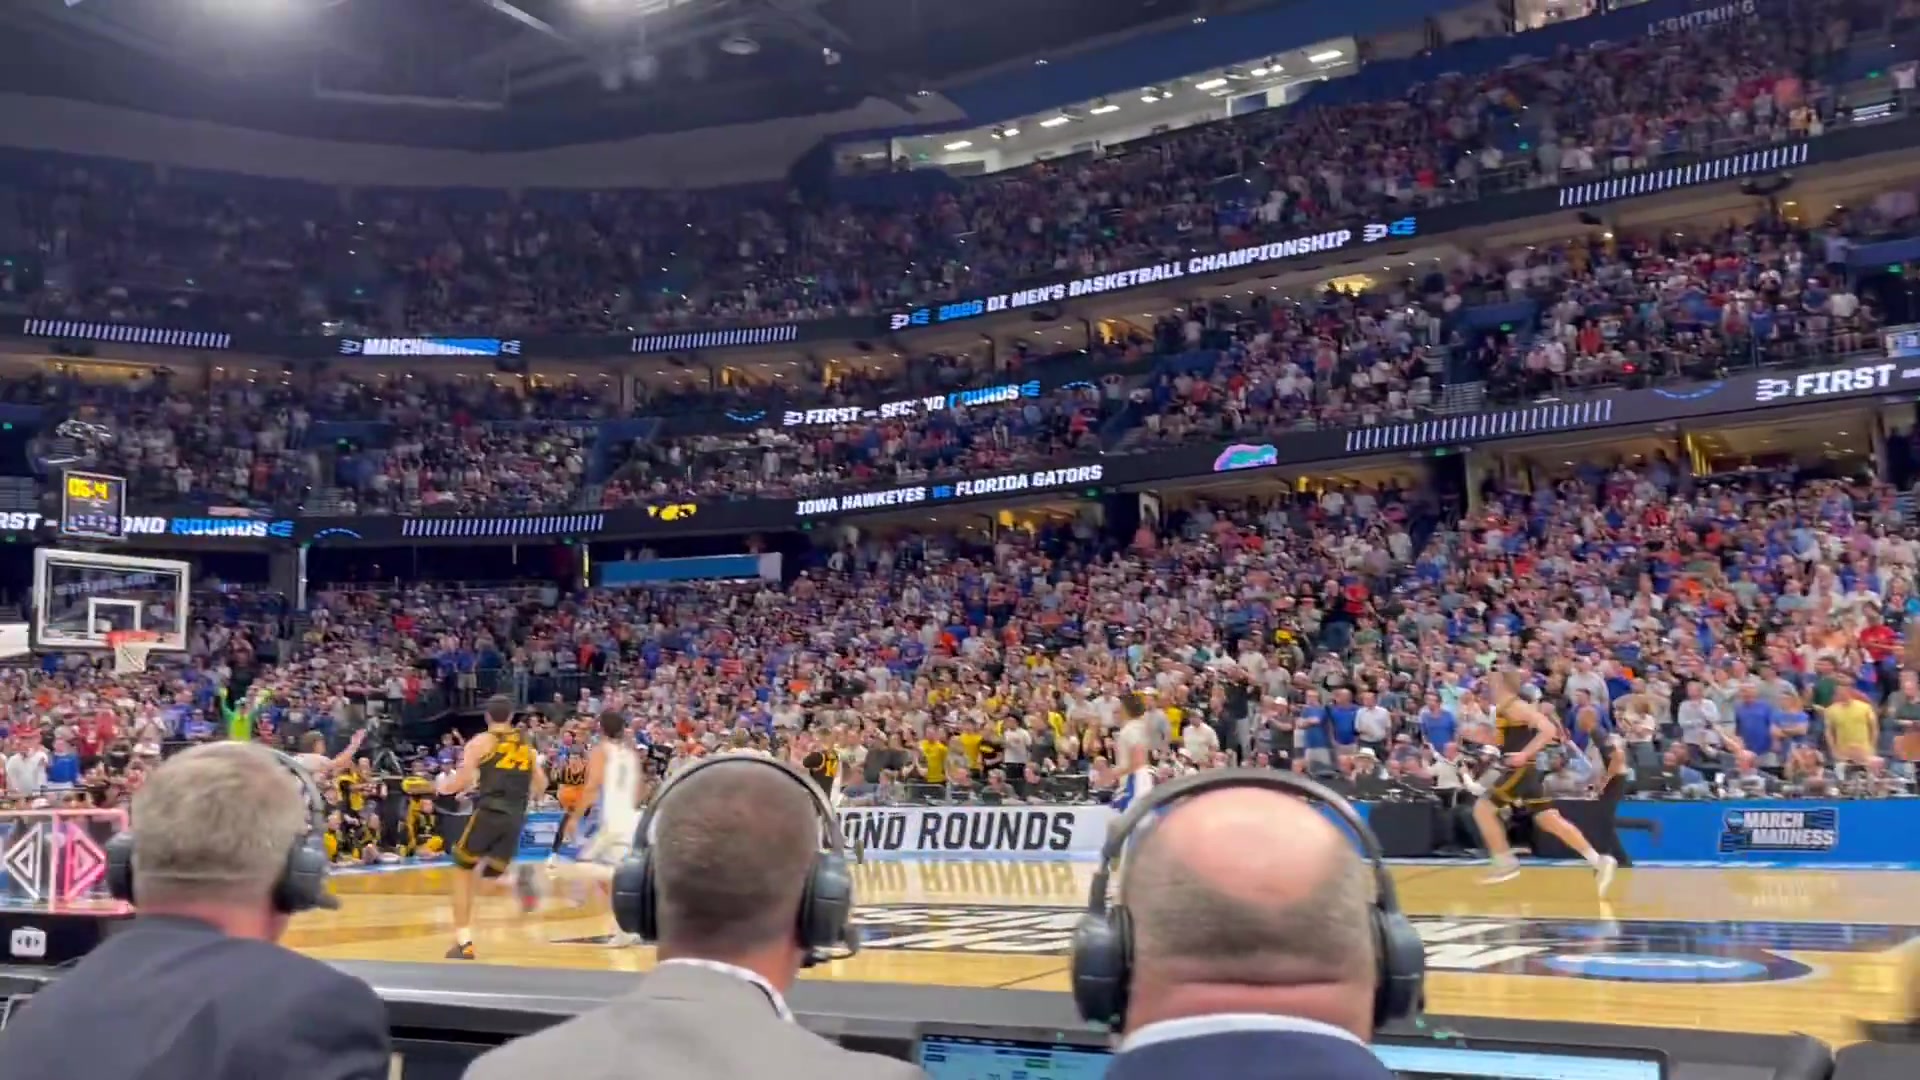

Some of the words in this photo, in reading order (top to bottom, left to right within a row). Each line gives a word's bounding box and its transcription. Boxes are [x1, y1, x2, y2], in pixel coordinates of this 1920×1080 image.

[986, 295, 1009, 312] DI
[1011, 283, 1065, 308] MEN'S
[1068, 261, 1184, 297] BASKETBALL
[1188, 229, 1351, 274] CHAMPIONSHIP
[363, 338, 423, 356] MARCH
[1795, 363, 1897, 397] FIRST
[805, 406, 861, 425] FIRST
[879, 395, 945, 418] SECND
[796, 498, 838, 515] IOWA
[841, 486, 926, 510] HAWKEYES
[955, 473, 1029, 497] FLORIDA
[1032, 464, 1103, 487] GATORS
[171, 518, 268, 537] ROUNDS
[496, 741, 529, 771] 24
[836, 811, 906, 850] OND
[917, 811, 1075, 851] ROUNDS
[1743, 811, 1805, 828] MARCH
[1752, 828, 1835, 845] MADNESS
